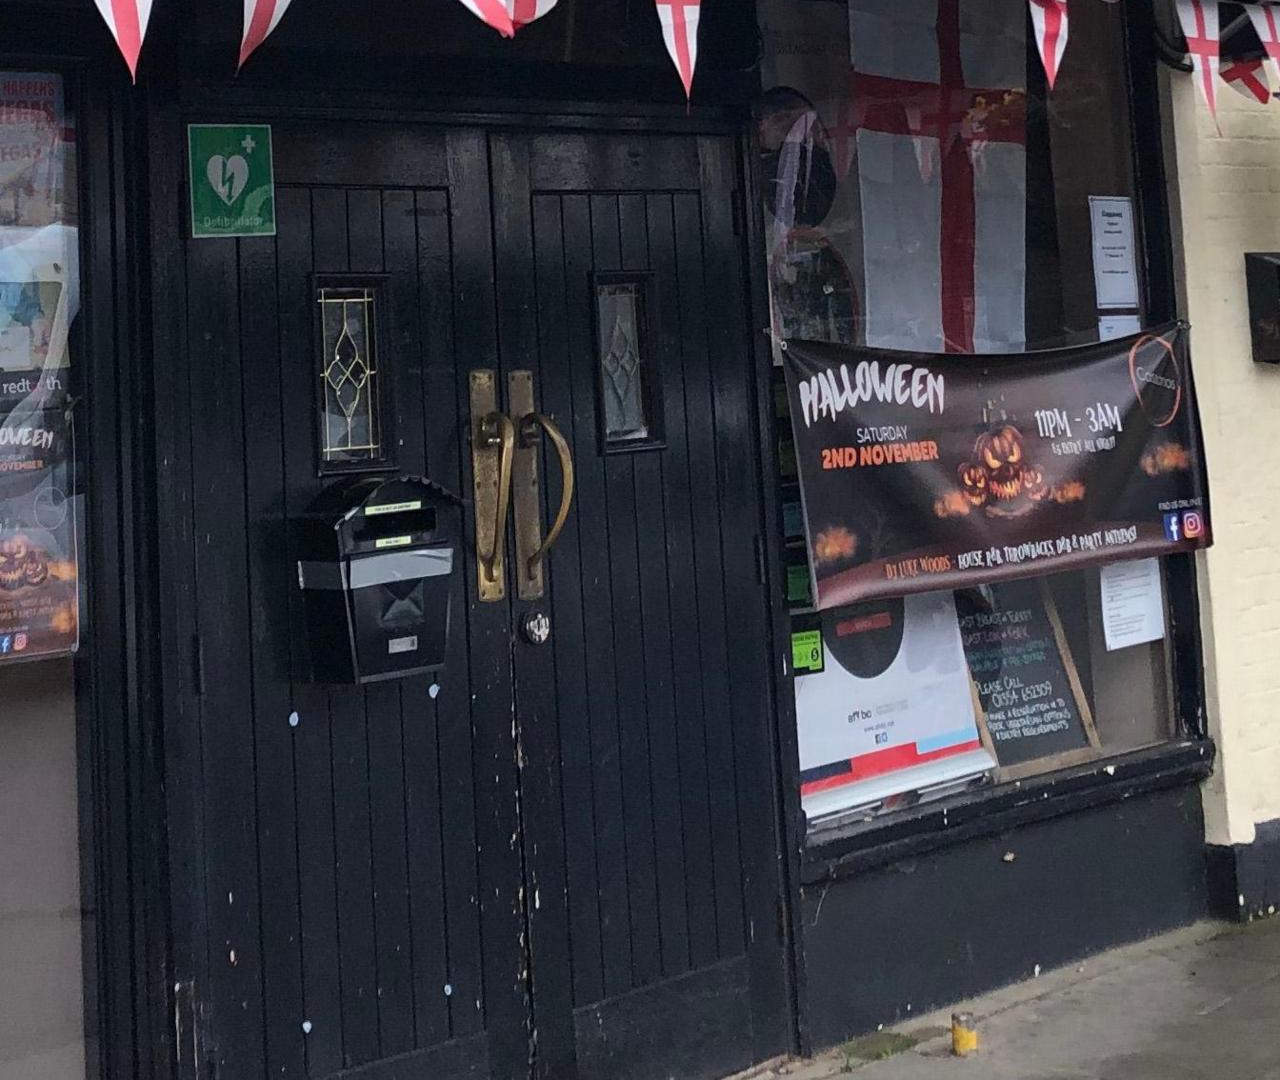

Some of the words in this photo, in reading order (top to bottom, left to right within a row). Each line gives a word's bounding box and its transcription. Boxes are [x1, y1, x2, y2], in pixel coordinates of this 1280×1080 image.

[799, 361, 945, 429] HALLOWEEN
[856, 425, 909, 444] SATURDAY
[1034, 408, 1072, 439] 11PM
[1085, 402, 1123, 433] 3AM
[821, 447, 857, 470] 2ND
[859, 440, 939, 466] NOVEMBER
[898, 558, 919, 578] LUKE
[919, 554, 952, 574] WOODS
[1079, 531, 1103, 551] PARTY
[1004, 675, 1024, 690] CALL
[1020, 681, 1052, 702] 652309
